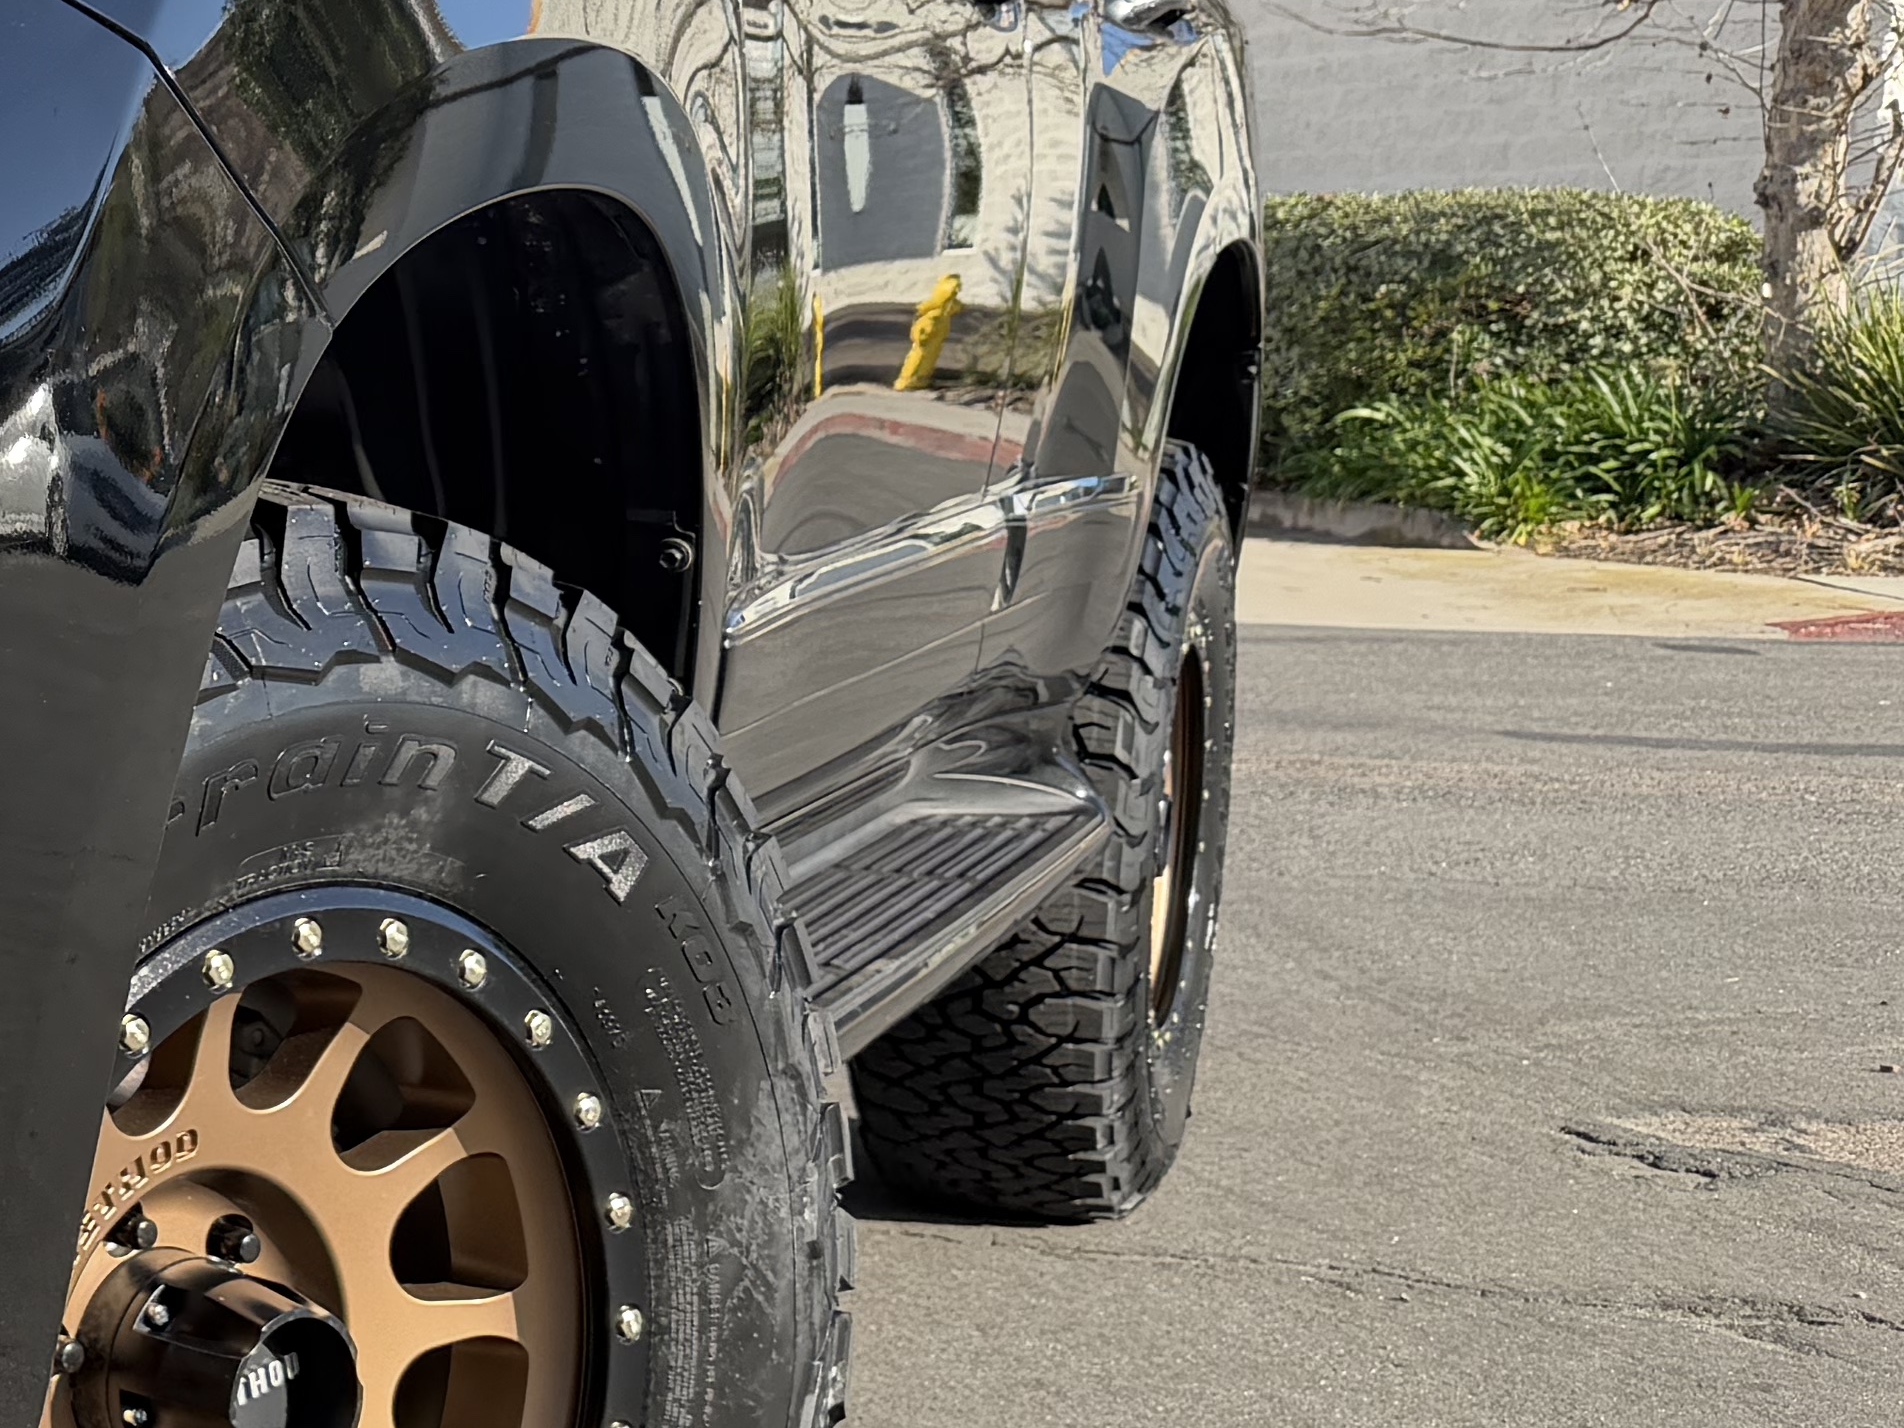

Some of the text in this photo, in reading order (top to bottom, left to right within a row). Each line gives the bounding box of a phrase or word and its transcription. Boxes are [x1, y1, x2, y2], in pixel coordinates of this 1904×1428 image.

[168, 714, 459, 838] rain
[474, 738, 650, 906] T/A
[72, 1128, 198, 1268] ETHOD
[236, 1351, 300, 1406] THOD
